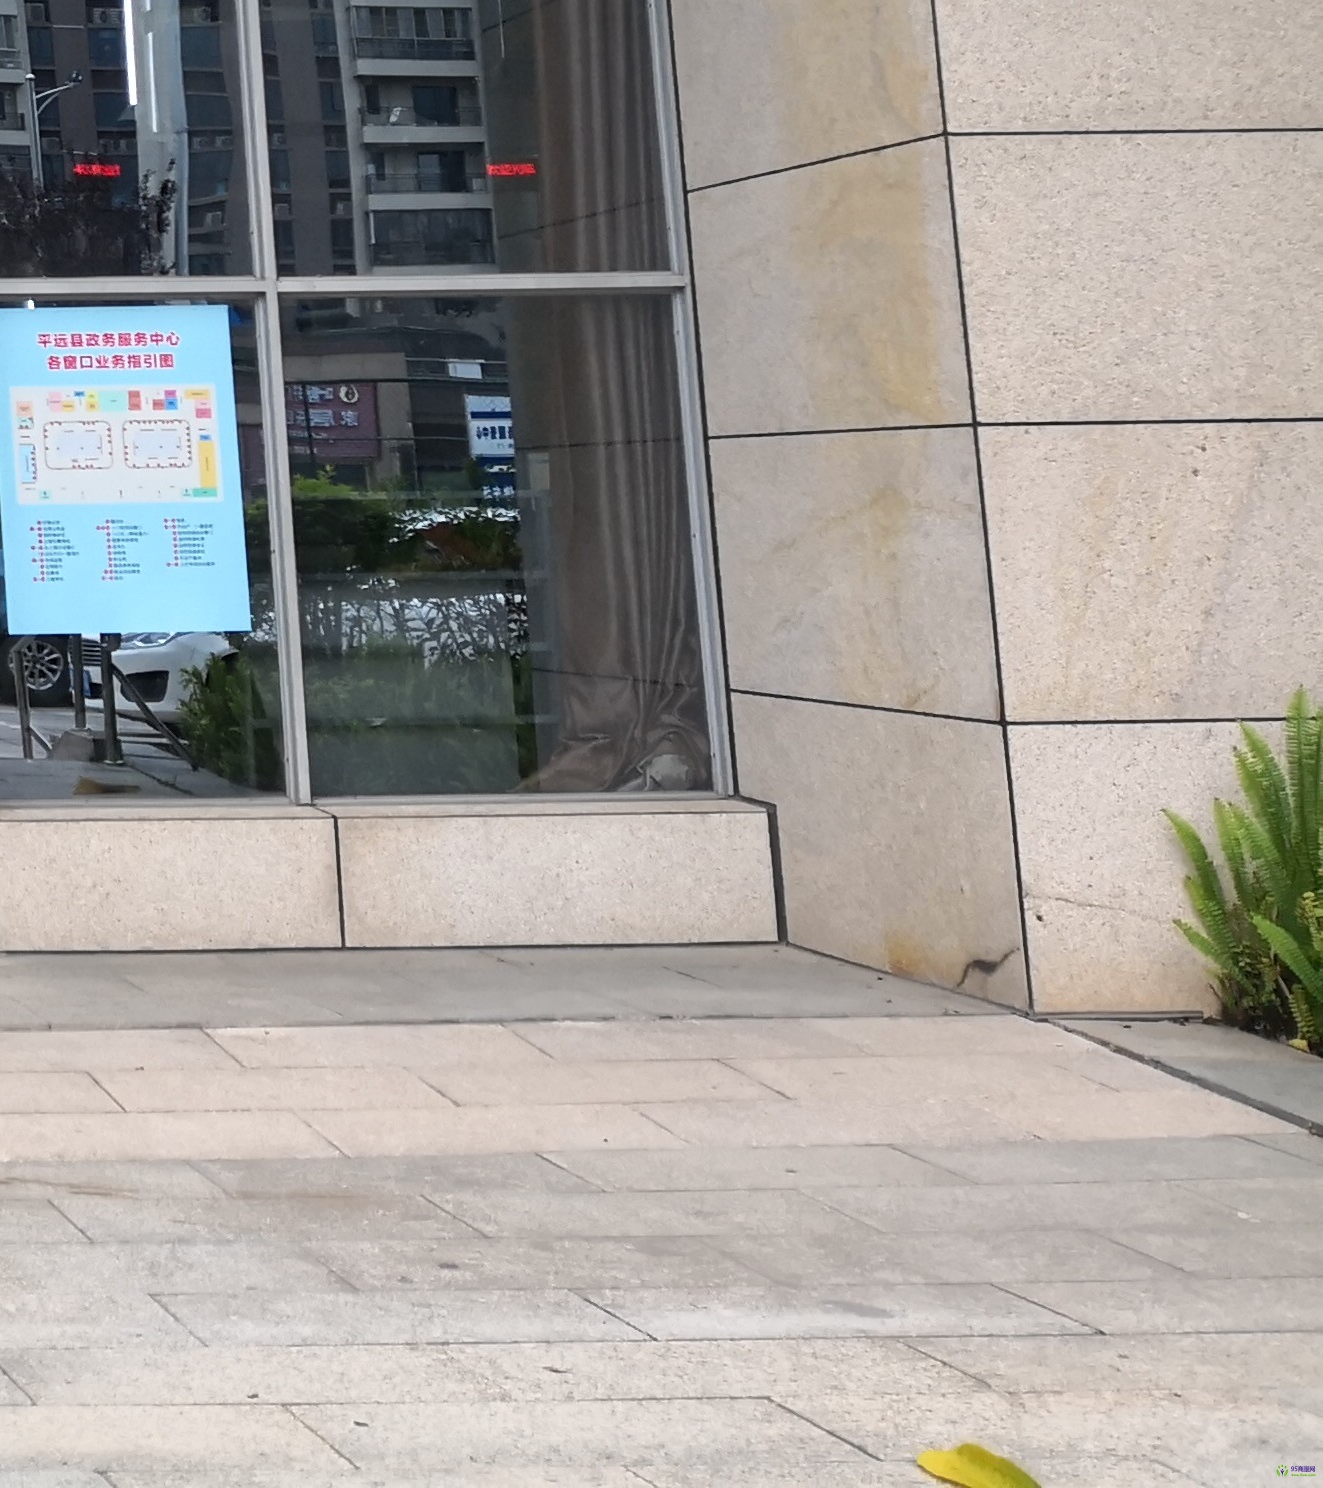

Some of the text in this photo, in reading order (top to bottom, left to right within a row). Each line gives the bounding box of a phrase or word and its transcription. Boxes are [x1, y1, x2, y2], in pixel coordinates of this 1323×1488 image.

[37, 331, 181, 348] 平远县政务服务中心
[47, 353, 175, 370] 各窗口业务指引图
